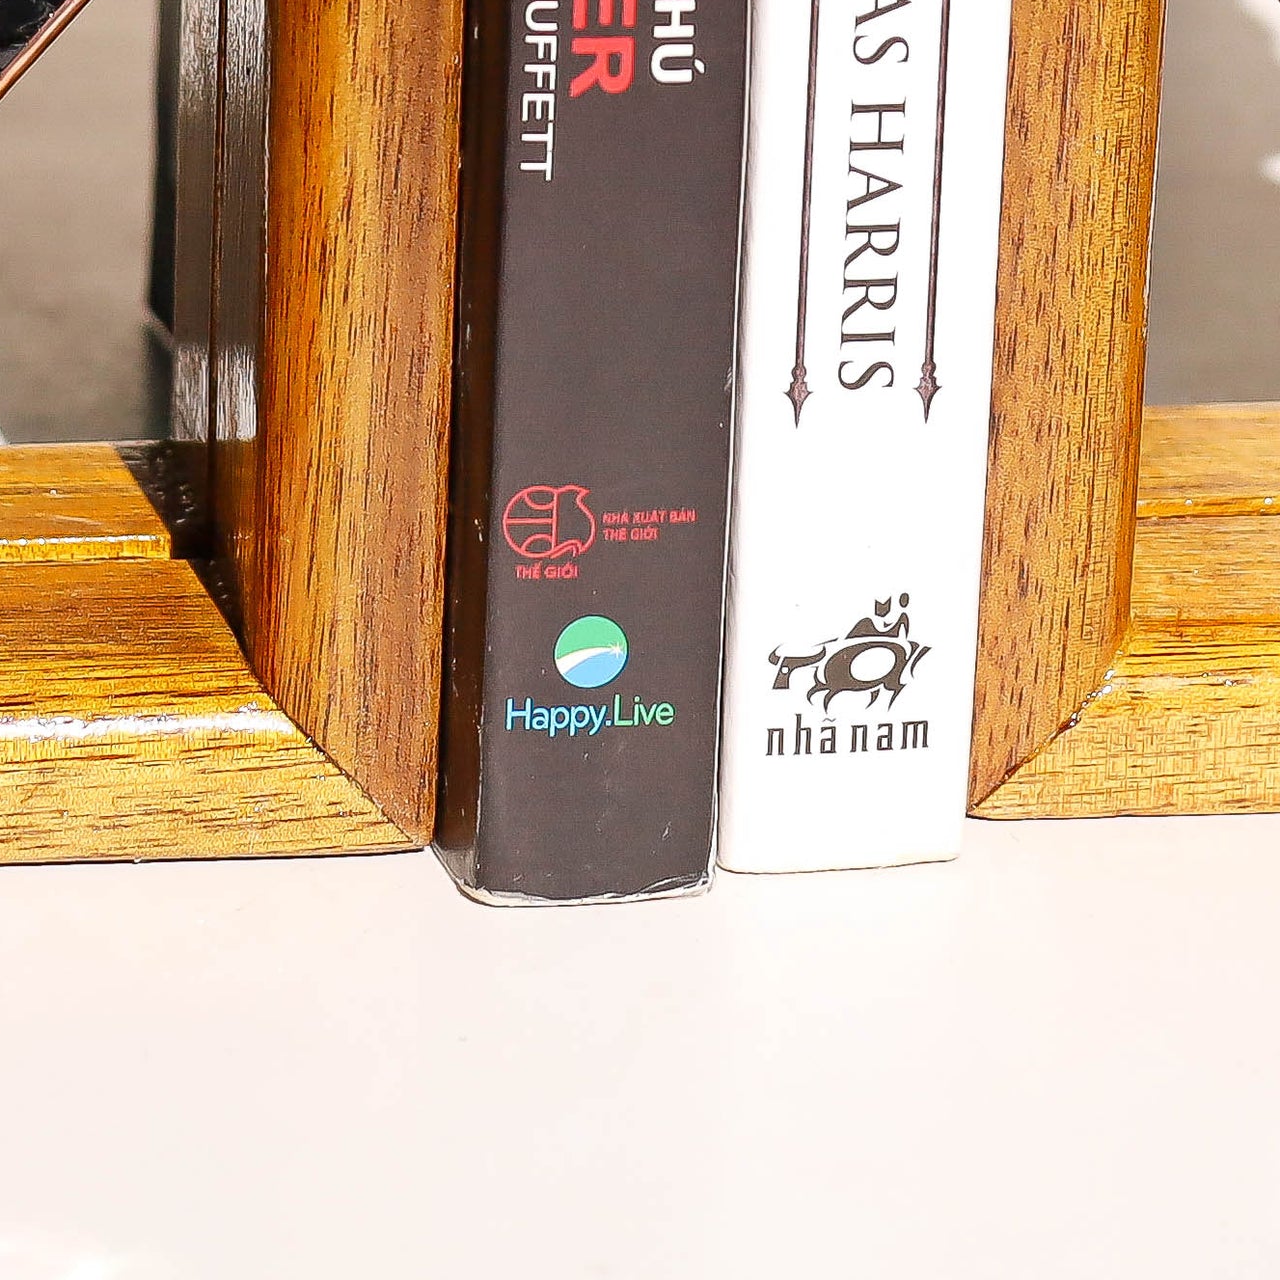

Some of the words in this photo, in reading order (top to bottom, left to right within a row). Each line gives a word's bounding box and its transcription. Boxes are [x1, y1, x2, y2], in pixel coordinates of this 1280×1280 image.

[837, 96, 907, 391] HARRIS
[515, 560, 542, 580] THẾ
[505, 694, 676, 738] Happy.Live
[765, 713, 837, 756] nhã
[850, 720, 929, 753] nam
